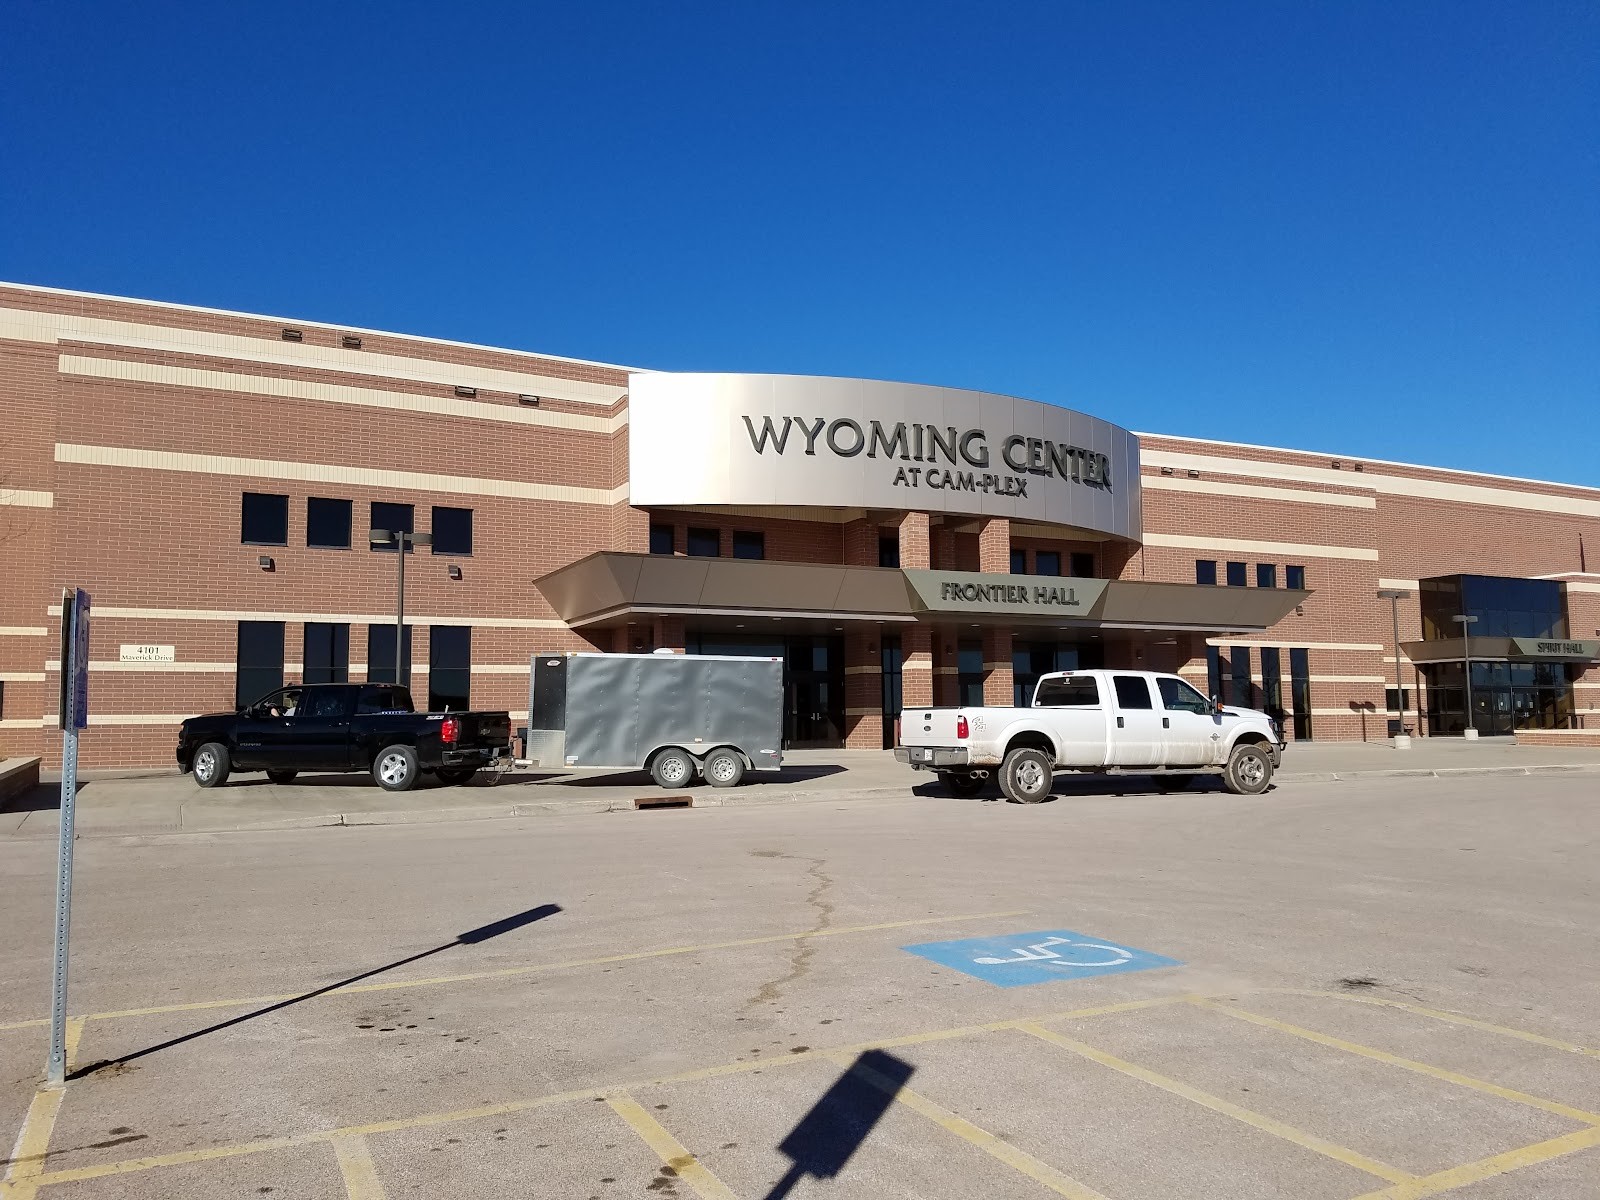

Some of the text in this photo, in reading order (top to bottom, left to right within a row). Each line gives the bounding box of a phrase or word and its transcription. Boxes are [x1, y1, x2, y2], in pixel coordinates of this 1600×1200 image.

[742, 415, 1113, 494] WYOMING CENTER
[893, 467, 1029, 498] AT CAM-PLEX
[941, 582, 1080, 606] FRONTIER HALL
[1563, 643, 1584, 654] HALL
